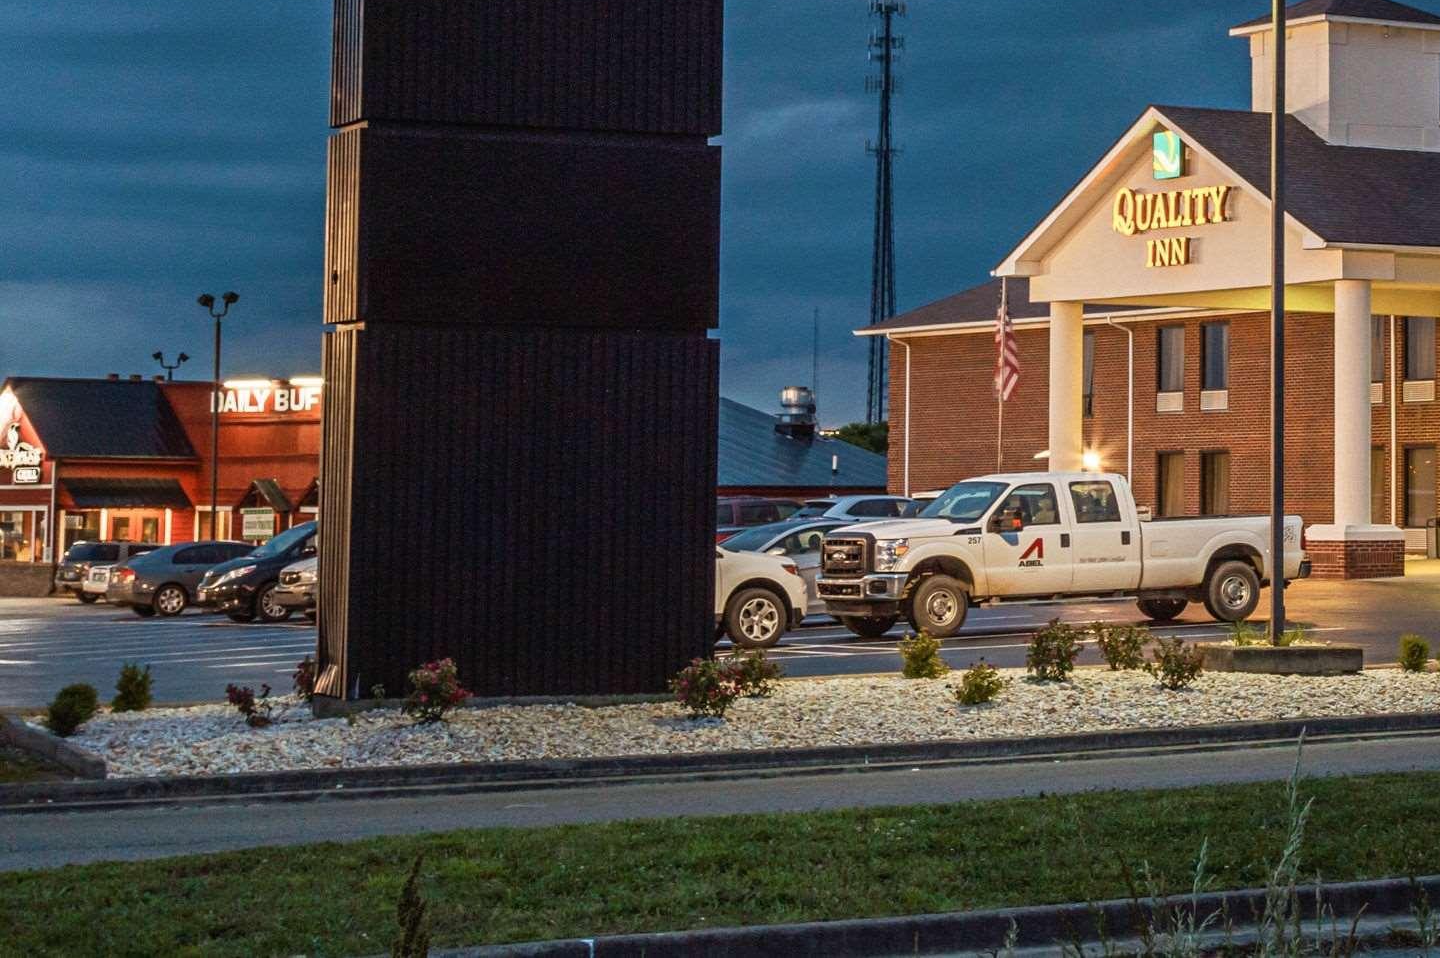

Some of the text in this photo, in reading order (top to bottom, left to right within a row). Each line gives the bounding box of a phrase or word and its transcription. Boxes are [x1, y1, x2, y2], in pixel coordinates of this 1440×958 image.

[1112, 186, 1231, 237] QUALITY
[1145, 236, 1190, 268] INN
[210, 387, 271, 413] DAILY
[967, 536, 982, 545] 257
